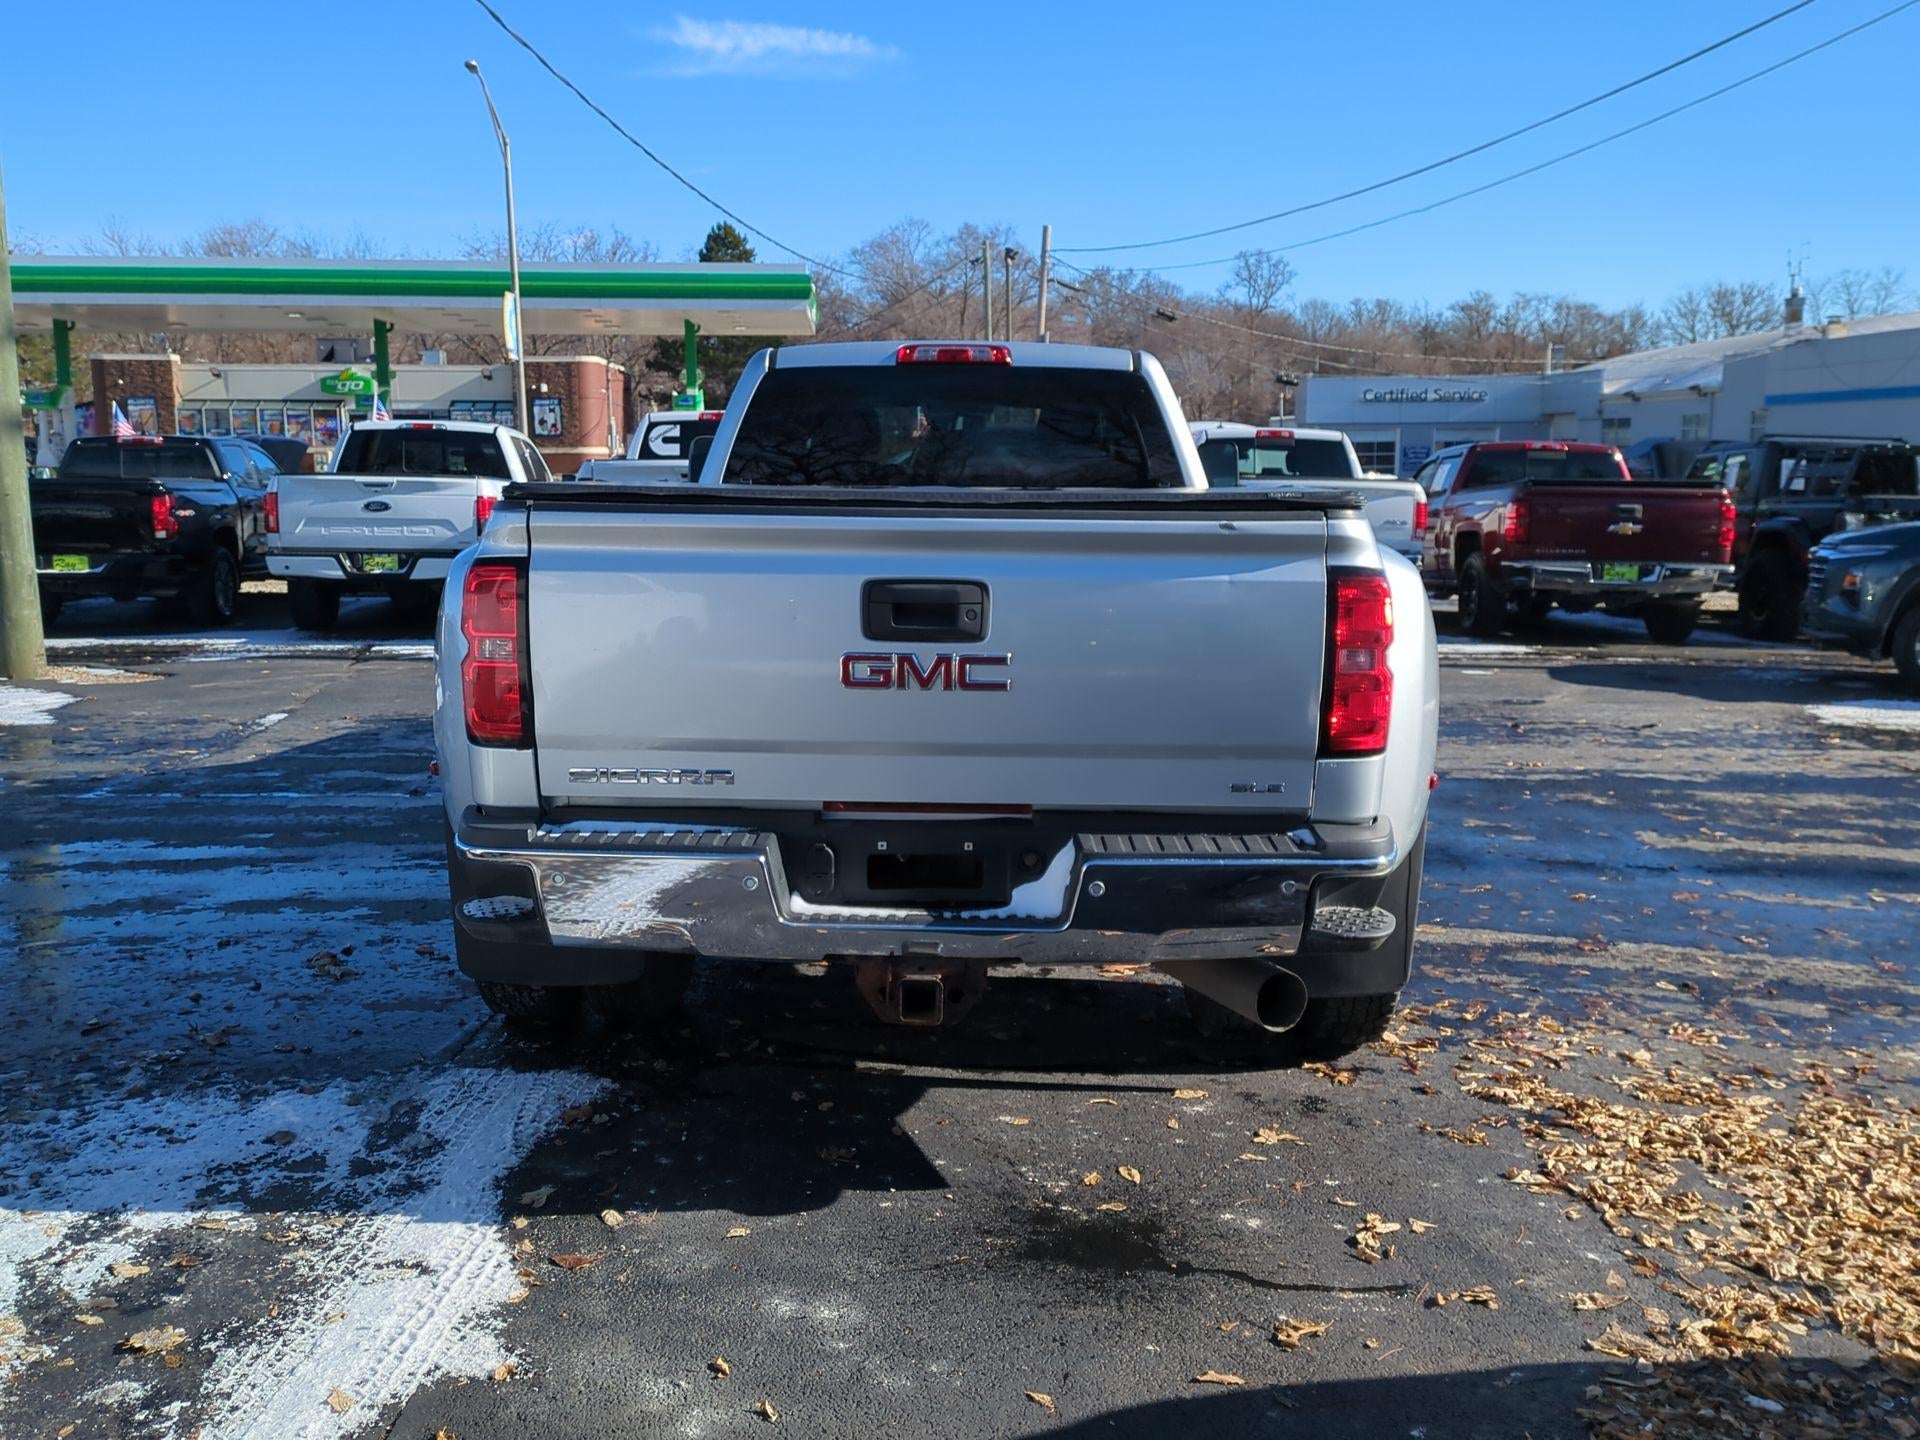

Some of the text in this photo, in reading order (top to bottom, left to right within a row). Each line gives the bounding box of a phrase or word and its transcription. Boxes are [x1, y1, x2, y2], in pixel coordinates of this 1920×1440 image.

[1363, 387, 1489, 402] Certified Service
[321, 527, 437, 537] F-150
[840, 651, 1012, 691] GMC
[568, 767, 735, 785] SIERRA
[1230, 781, 1286, 793] SLE
